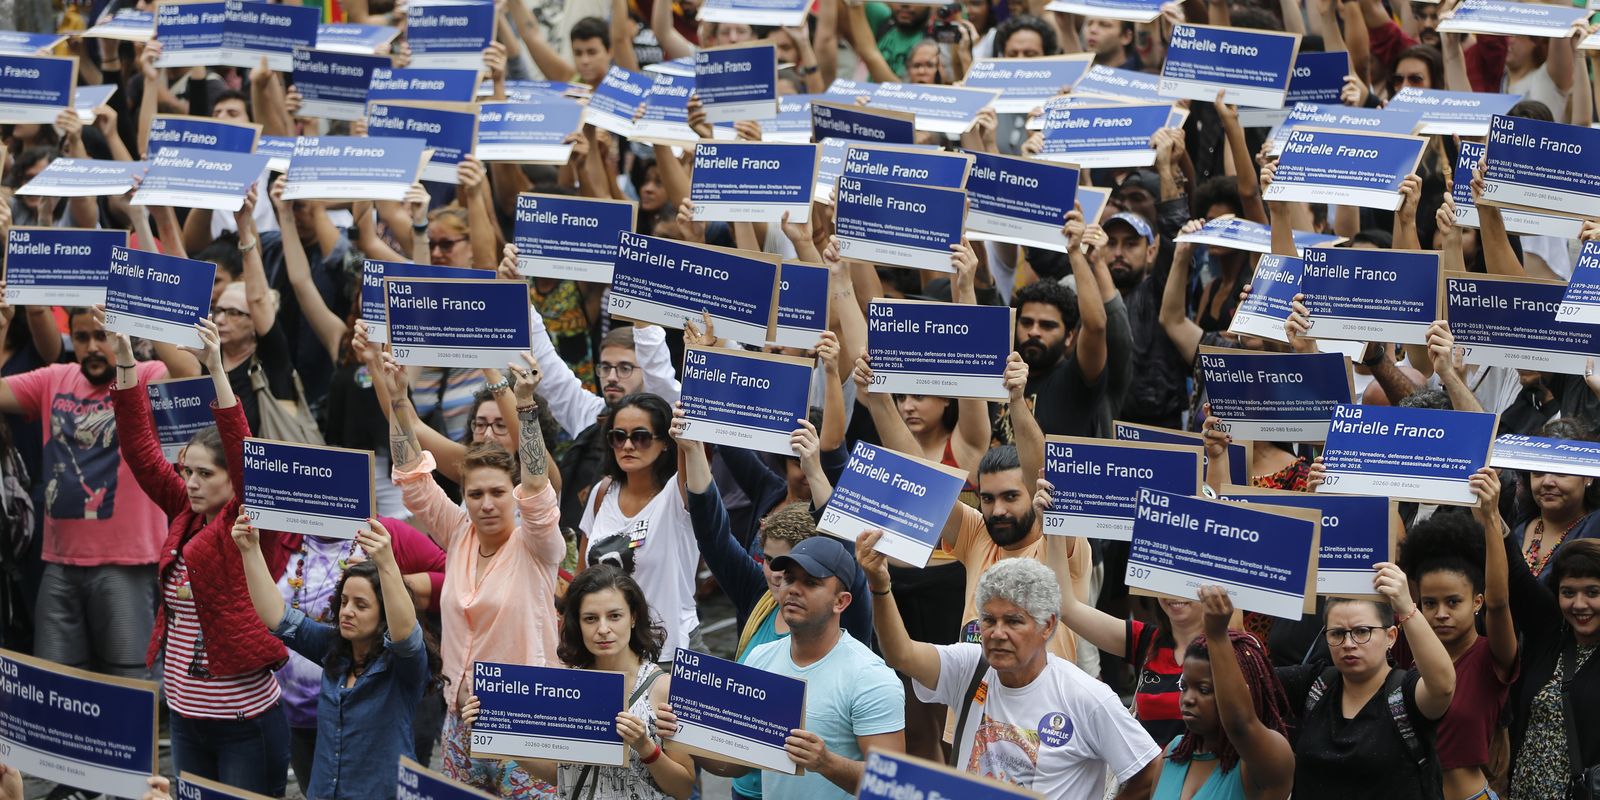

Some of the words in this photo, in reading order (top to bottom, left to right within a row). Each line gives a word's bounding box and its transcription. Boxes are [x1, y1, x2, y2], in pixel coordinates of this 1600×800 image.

[225, 0, 243, 11] Rua
[224, 12, 260, 24] Marielle
[262, 15, 293, 26] Franco
[1174, 26, 1197, 37] Rua
[1171, 37, 1216, 51] Marielle
[1220, 42, 1258, 56] Franco
[372, 69, 391, 78] Rua
[369, 79, 408, 89] Marielle
[411, 81, 445, 90] Franco
[813, 105, 830, 117] Rua
[1048, 109, 1070, 118] Rua
[814, 116, 850, 132] Marielle
[853, 123, 884, 138] Franco
[1044, 118, 1089, 129] Marielle
[1093, 117, 1132, 126] Franco
[1492, 115, 1514, 129] Rua
[296, 137, 319, 146] Rua
[1290, 131, 1315, 141] Rua
[1490, 129, 1535, 147] Marielle
[1540, 137, 1581, 154] Franco
[293, 147, 340, 157] Marielle
[344, 148, 385, 157] Franco
[696, 144, 716, 155] Rua
[848, 148, 870, 160] Rua
[1285, 142, 1333, 154] Marielle
[1336, 145, 1378, 158] Franco
[694, 157, 737, 168] Marielle
[742, 158, 779, 169] Franco
[845, 161, 888, 175] Marielle
[892, 165, 928, 178] Franco
[840, 177, 860, 190] Rua
[1268, 185, 1285, 195] 307
[517, 197, 537, 209] Rua
[839, 190, 882, 206] Marielle
[887, 197, 926, 213] Franco
[516, 210, 557, 224] Marielle
[562, 214, 598, 227] Franco
[9, 230, 29, 241] Rua
[621, 232, 647, 248] Rua
[9, 243, 50, 254] Marielle
[54, 243, 90, 254] Franco
[111, 247, 128, 261] Rua
[1305, 249, 1326, 262] Rua
[618, 245, 674, 268] Marielle
[680, 259, 729, 280] Franco
[110, 261, 144, 278] Marielle
[147, 267, 180, 284] Franco
[1304, 264, 1349, 278] Marielle
[1354, 266, 1396, 281] Franco
[389, 282, 411, 294] Rua
[1449, 280, 1476, 292] Rua
[390, 296, 437, 308] Marielle
[442, 297, 485, 310] Franco
[653, 288, 689, 300] covardemente
[689, 296, 720, 306] assassinada
[676, 287, 700, 296] defensora
[712, 294, 732, 303] Direitos
[733, 299, 757, 309] Humanos
[1450, 294, 1506, 308] Marielle
[1513, 297, 1560, 312] Franco
[612, 298, 631, 311] 307
[870, 304, 892, 316] Rua
[1560, 306, 1580, 317] 307
[106, 314, 117, 325] 307
[870, 318, 919, 332] Marielle
[925, 320, 968, 334] Franco
[1236, 316, 1250, 326] 307
[394, 349, 410, 359] 307
[686, 351, 706, 364] Rua
[1201, 356, 1225, 367] Rua
[684, 365, 726, 382] Marielle
[730, 371, 769, 389] Franco
[1204, 370, 1253, 382] Marielle
[1257, 370, 1302, 382] Franco
[1335, 405, 1362, 418] Rua
[1118, 426, 1140, 440] Rua
[1331, 419, 1388, 434] Marielle
[1394, 423, 1445, 438] Franco
[1500, 433, 1530, 441] Rua
[244, 442, 264, 455] Rua
[853, 441, 876, 460] Rua
[1047, 444, 1072, 457] Rua
[244, 456, 288, 472] Marielle
[293, 461, 331, 477] Franco
[1047, 459, 1100, 475] Marielle
[1106, 463, 1152, 479] Franco
[847, 456, 890, 483] Marielle
[891, 473, 927, 497] Franco
[1140, 489, 1169, 507] Rua
[823, 512, 841, 525] 307
[1044, 516, 1065, 528] 307
[1138, 505, 1198, 530] Marielle
[1204, 518, 1259, 542] Franco
[1130, 567, 1151, 582] 307
[967, 624, 981, 634] EL
[676, 648, 699, 666] Rua
[476, 663, 501, 677] Rua
[674, 663, 721, 688] Marielle
[726, 677, 766, 700] Franco
[475, 678, 528, 694] Marielle
[535, 683, 579, 699] Franco
[49, 690, 99, 716] Franco
[1041, 727, 1069, 740] MARIELLE
[474, 736, 492, 747] 307
[1046, 736, 1061, 745] VIVE
